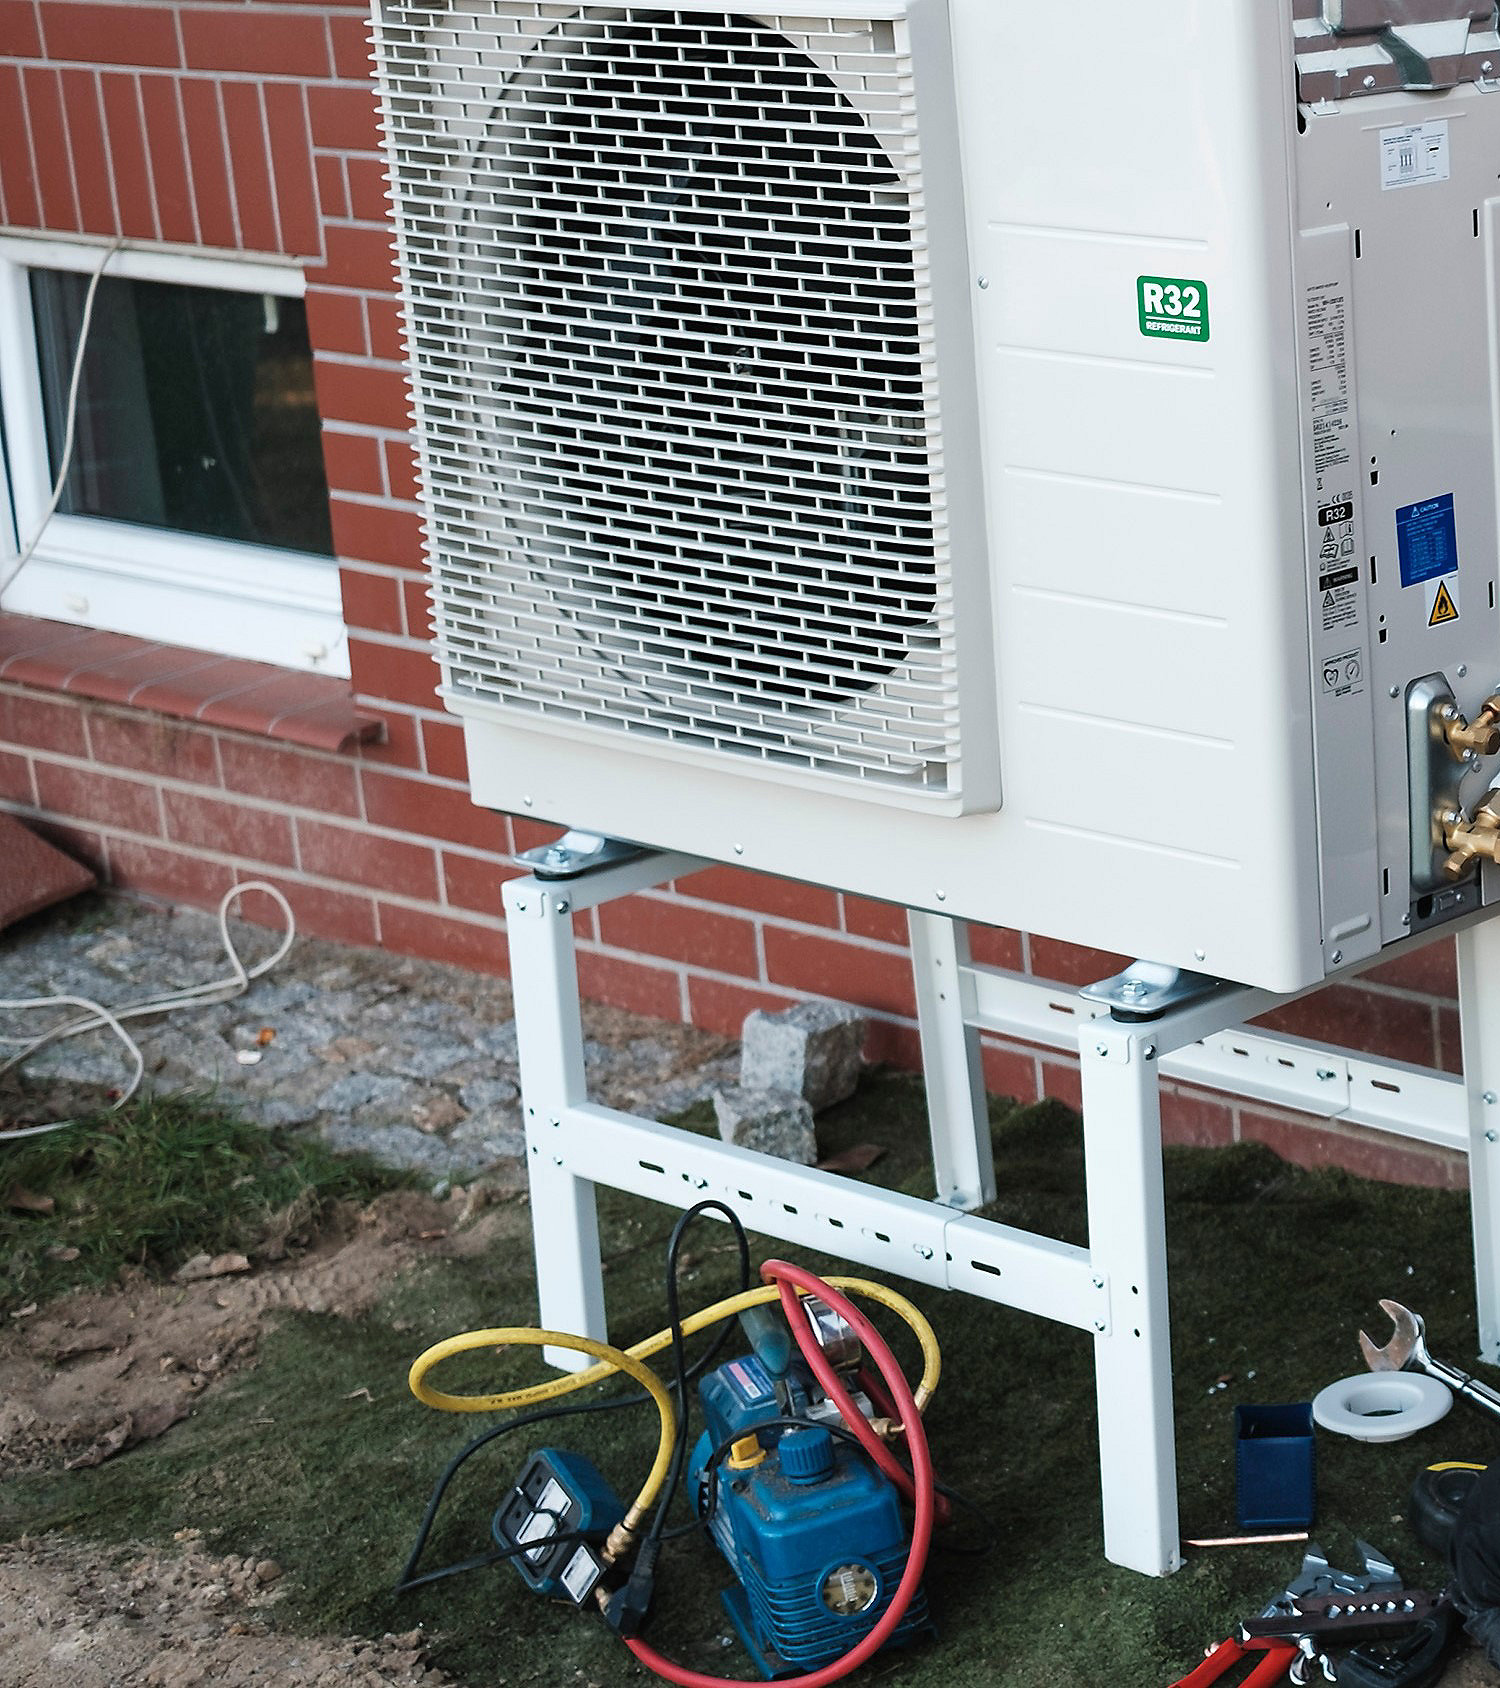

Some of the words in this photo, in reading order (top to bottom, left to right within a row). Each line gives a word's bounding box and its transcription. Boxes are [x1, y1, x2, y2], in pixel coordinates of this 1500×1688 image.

[1143, 282, 1201, 318] R32
[1145, 321, 1201, 335] REFRIGERANT
[1326, 506, 1346, 522] R32
